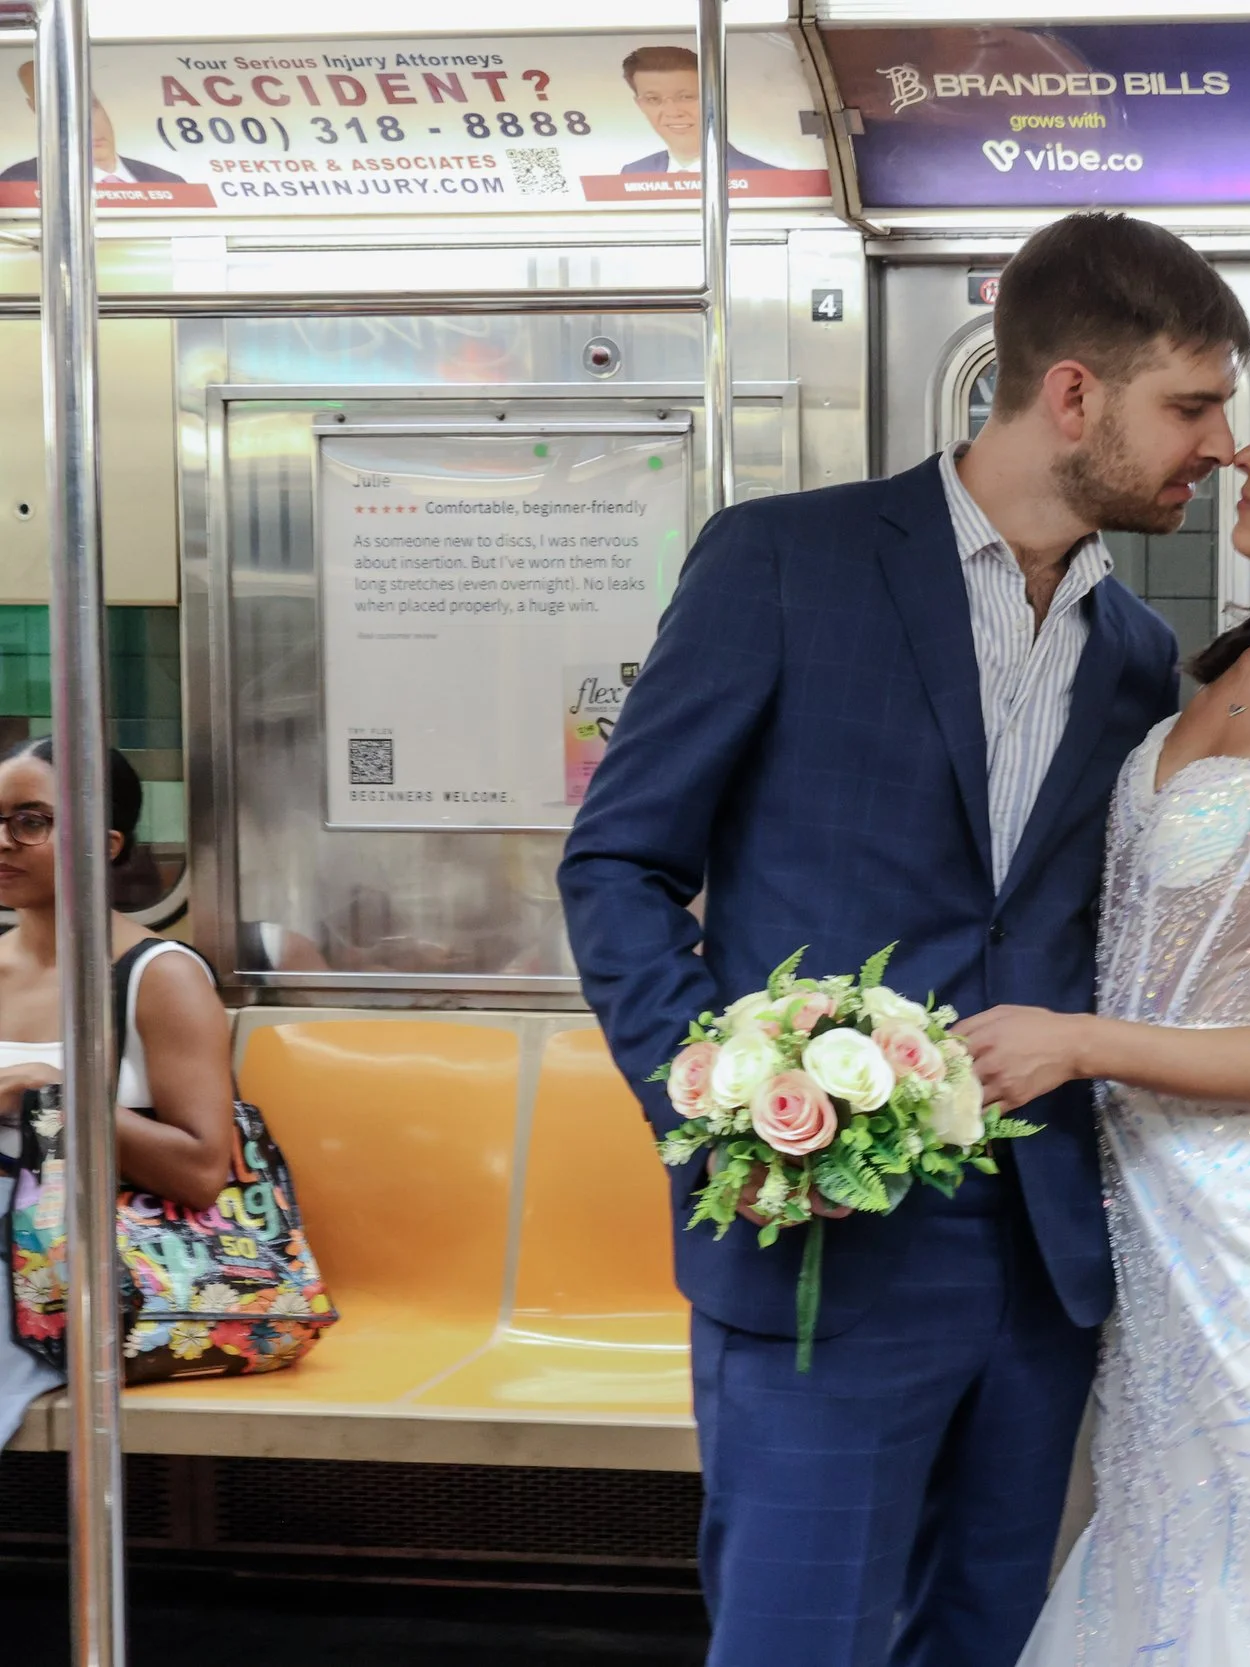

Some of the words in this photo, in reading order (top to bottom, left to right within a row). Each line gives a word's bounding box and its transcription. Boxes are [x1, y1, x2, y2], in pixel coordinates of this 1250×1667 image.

[177, 57, 227, 70] Your
[234, 56, 317, 70] Serious
[323, 54, 386, 71] Injury
[396, 51, 503, 67] Attorneys
[161, 69, 551, 107] ACCIDENT?
[933, 72, 1117, 97] BRANDED
[1123, 71, 1231, 96] BILLS
[157, 117, 290, 152] (800)
[310, 115, 405, 144] 318
[463, 110, 591, 139] 8888
[1010, 113, 1066, 131] grows
[1068, 112, 1106, 128] with
[209, 158, 318, 174] SPEKTOR
[327, 158, 343, 172] &
[351, 154, 497, 172] ASSOCIATES
[1025, 141, 1144, 171] vibe.co
[220, 176, 505, 198] CRASHINJURY.COM
[624, 180, 673, 192] MIKHAIL
[817, 293, 837, 318] 4
[425, 501, 519, 516] Comfortable,
[522, 500, 648, 518] beginner-friendly
[353, 535, 371, 548] As
[374, 535, 441, 548] someone
[443, 536, 474, 548] new
[477, 536, 492, 548] to
[495, 533, 537, 549] discs,
[547, 535, 577, 548] was
[580, 535, 639, 548] nervous
[354, 555, 397, 569] about
[400, 555, 468, 569] insertion.
[471, 555, 496, 569] But
[500, 555, 525, 569] I've
[528, 556, 566, 569] worn
[570, 555, 608, 569] them
[611, 554, 632, 569] for
[354, 577, 387, 594] long
[390, 577, 454, 591] stretches
[458, 578, 498, 593] (even
[501, 577, 580, 595] overnight).
[583, 577, 605, 591] No
[608, 576, 645, 591] leaks
[354, 598, 395, 612] when
[398, 598, 446, 615] placed
[449, 598, 514, 615] properly,
[517, 601, 526, 612] a
[528, 598, 566, 616] huge
[569, 598, 599, 612] win.
[569, 677, 623, 715] flex
[350, 790, 433, 801] BEGINNERS
